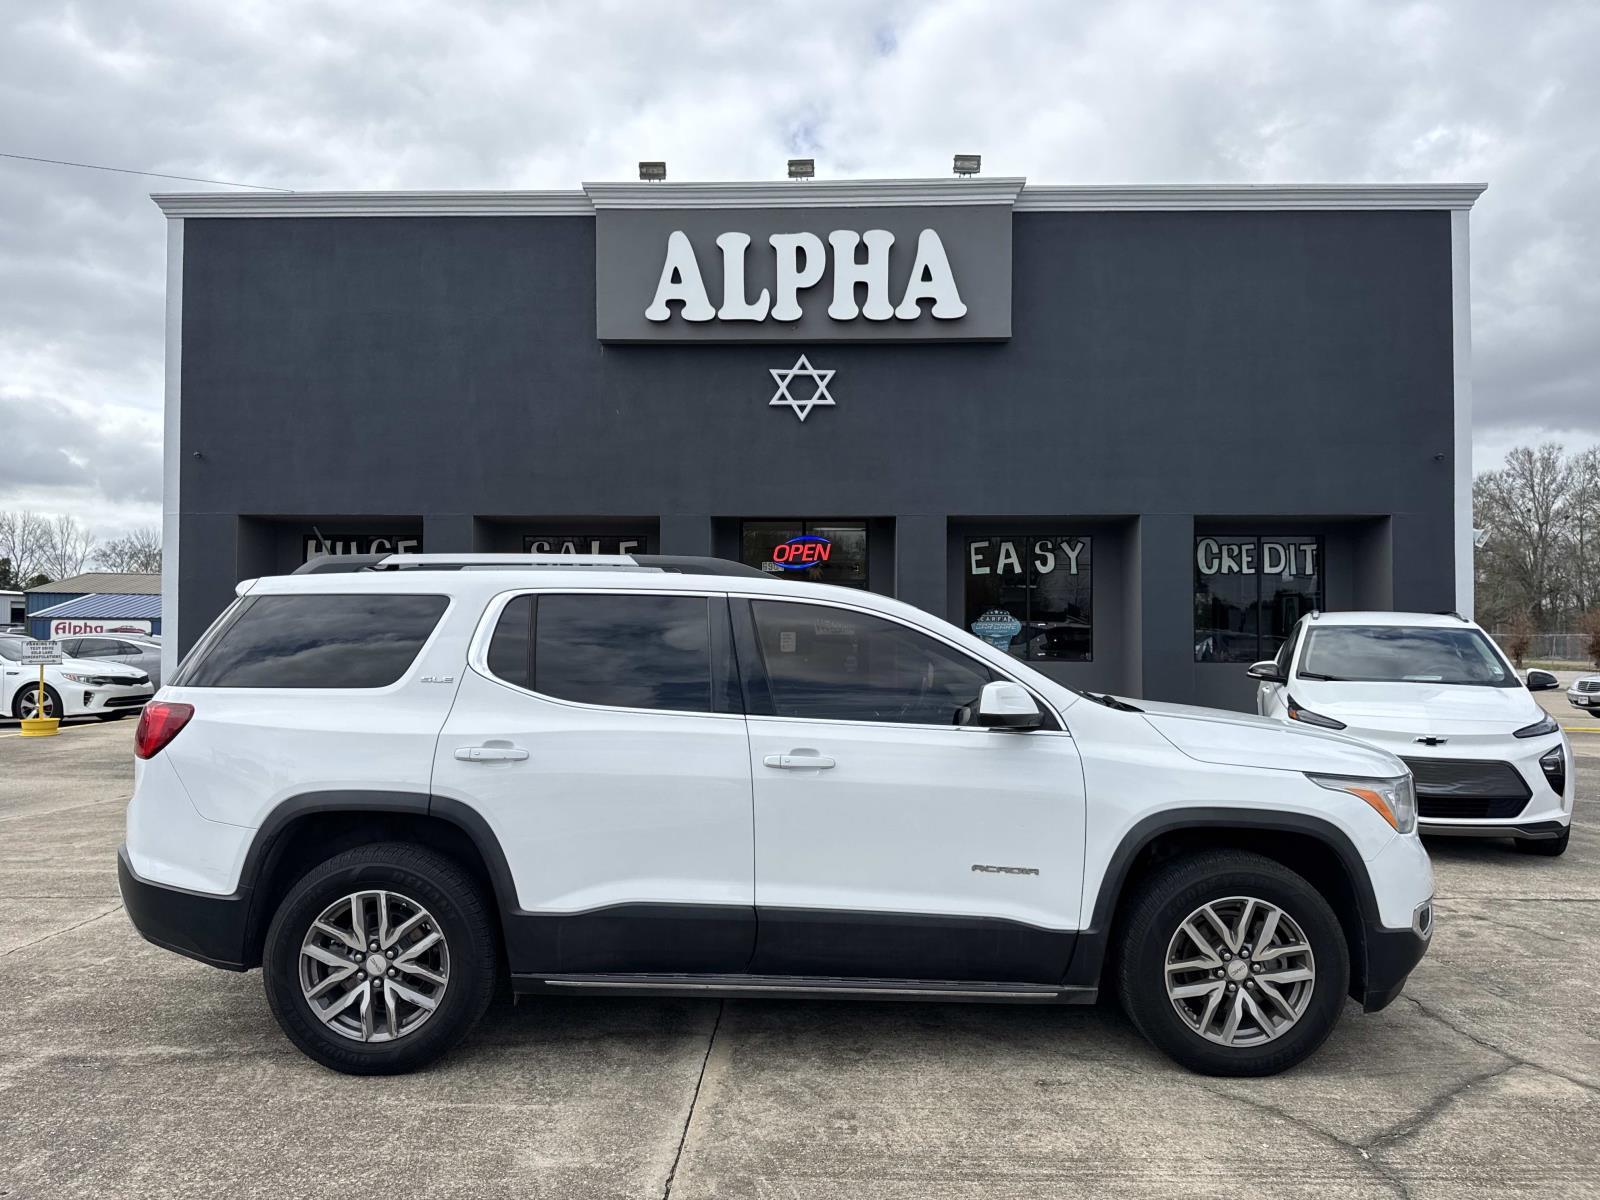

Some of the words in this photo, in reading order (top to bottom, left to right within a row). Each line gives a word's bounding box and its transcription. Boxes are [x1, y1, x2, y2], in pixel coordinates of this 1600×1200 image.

[645, 228, 968, 322] ALPHA
[773, 544, 832, 562] OPEN
[970, 540, 1084, 575] EASY
[1197, 538, 1318, 575] CREDIT
[55, 622, 104, 635] Alpha
[420, 676, 454, 684] SLE
[971, 864, 1040, 876] ACADIA
